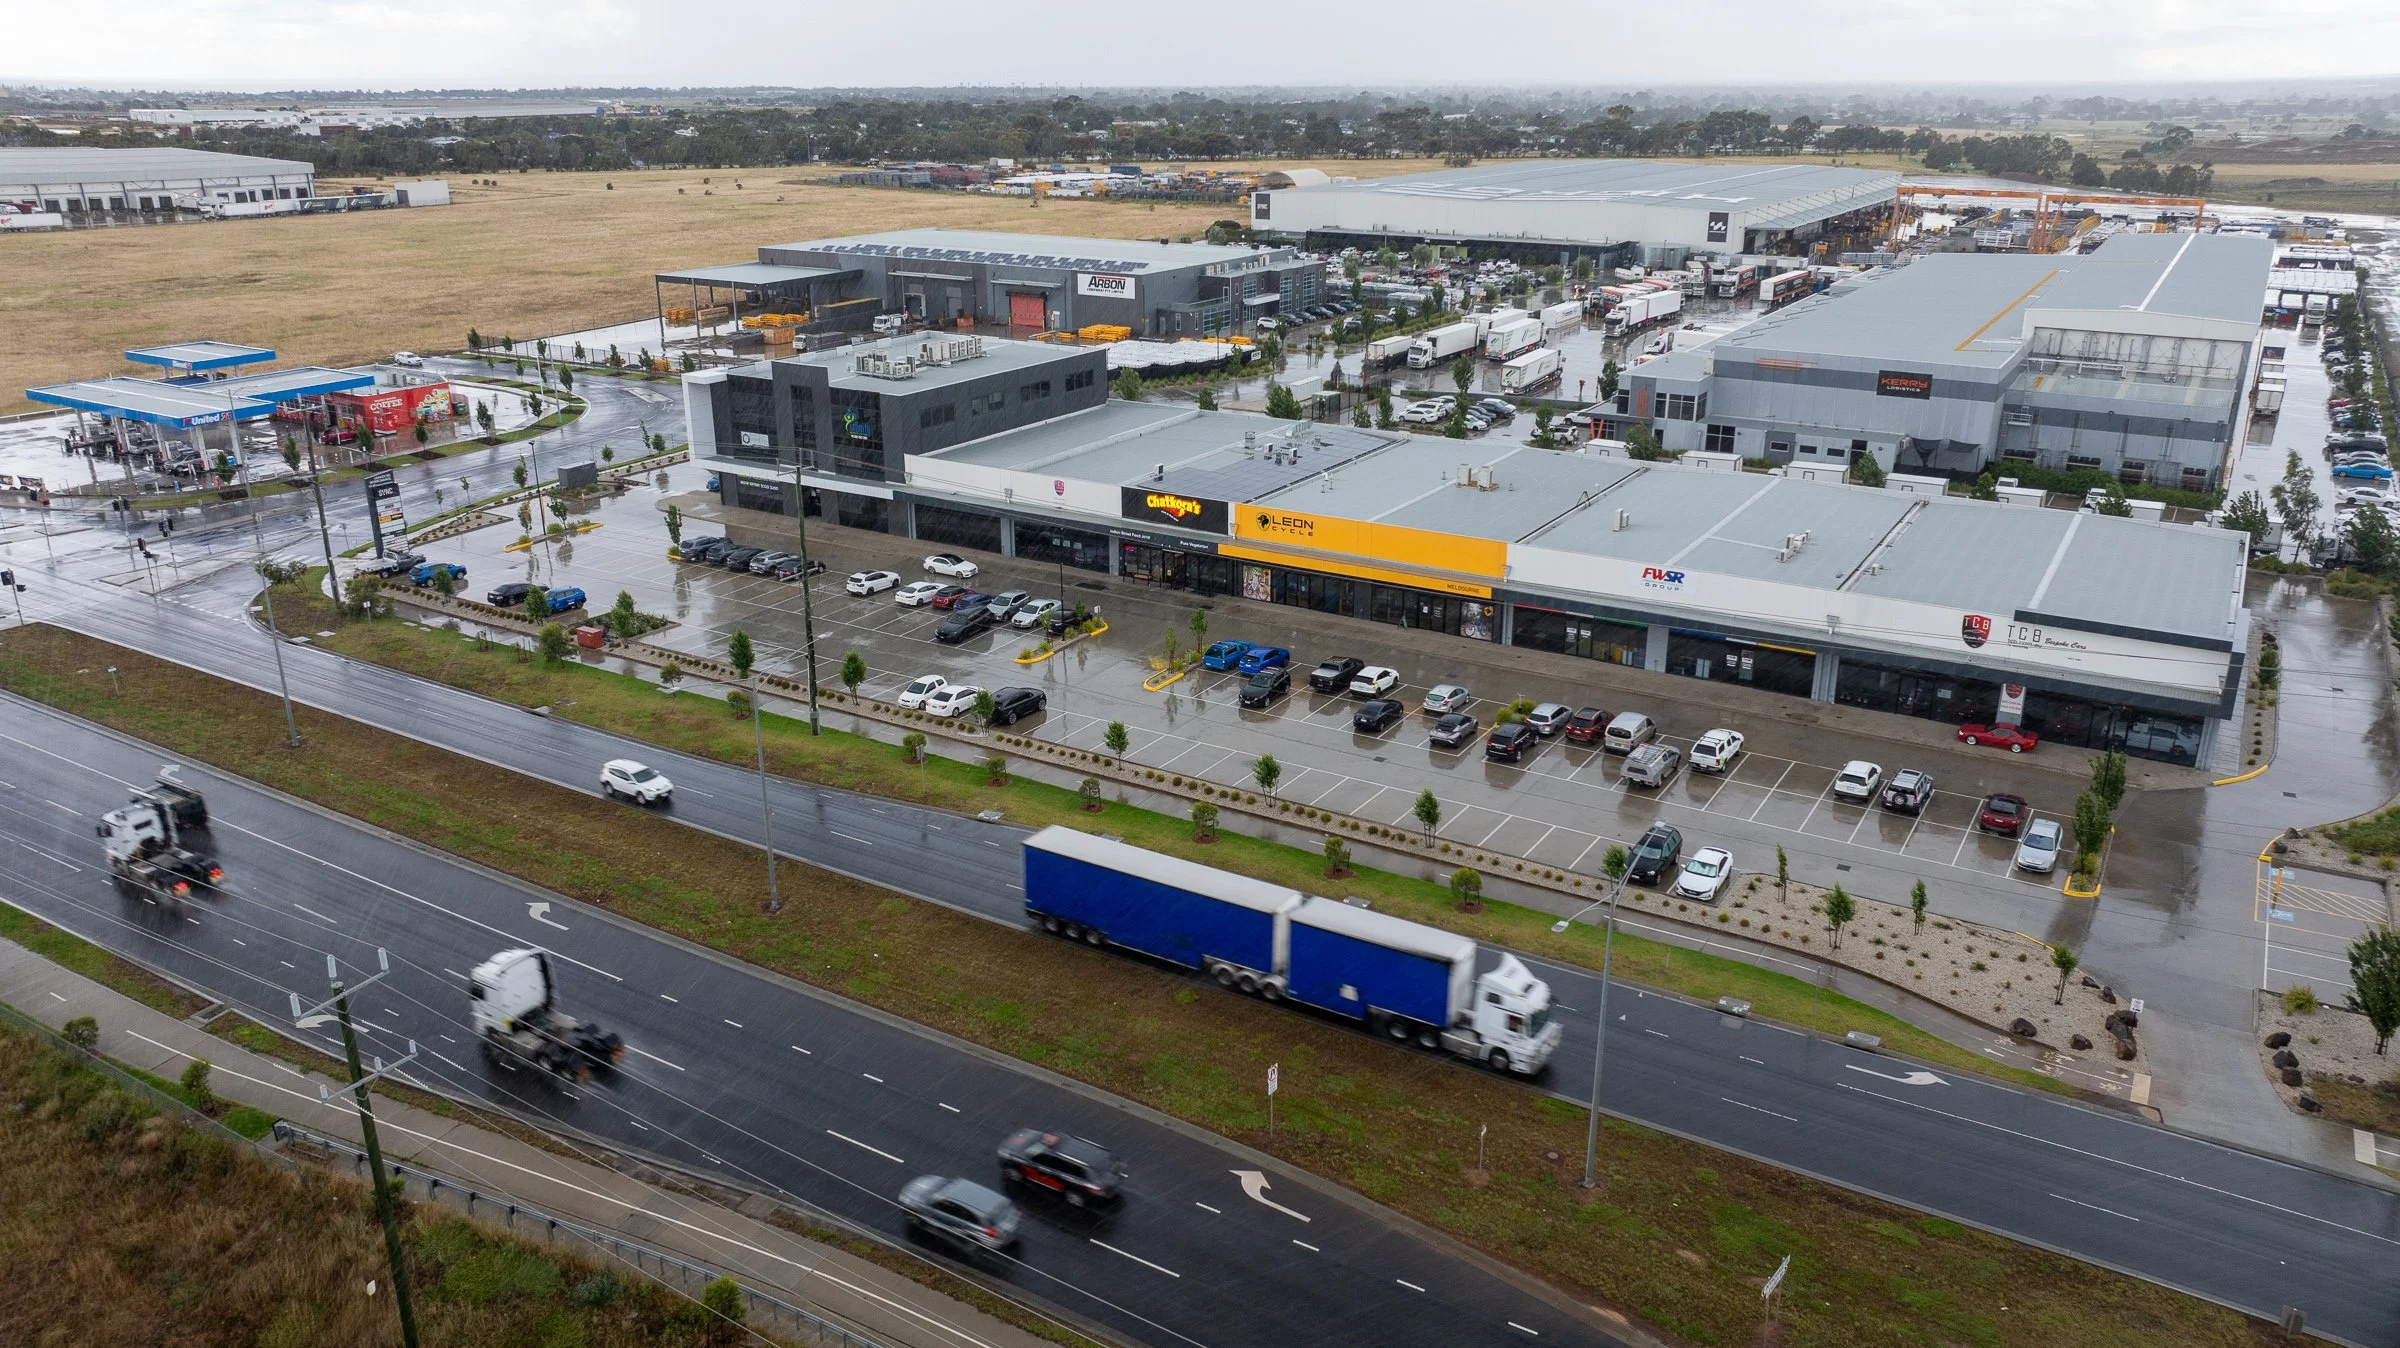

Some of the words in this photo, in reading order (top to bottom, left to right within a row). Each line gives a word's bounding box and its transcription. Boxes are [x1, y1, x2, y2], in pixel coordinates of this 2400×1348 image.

[1088, 276, 1126, 290] ARBON
[1881, 378, 1928, 388] KERRY
[370, 399, 403, 411] COFFEE
[191, 413, 220, 426] United
[378, 488, 394, 497] SYNC
[1146, 494, 1202, 515] Chatkora's
[1272, 515, 1313, 529] LEON
[1272, 526, 1313, 537] CYCLE
[1642, 568, 1685, 584] FWSR
[1447, 584, 1480, 593] MELBOURNE
[1645, 583, 1679, 591] GROUP
[1964, 616, 1990, 630] TCB
[2008, 625, 2041, 643] TCB
[2045, 638, 2069, 647] Bespoke
